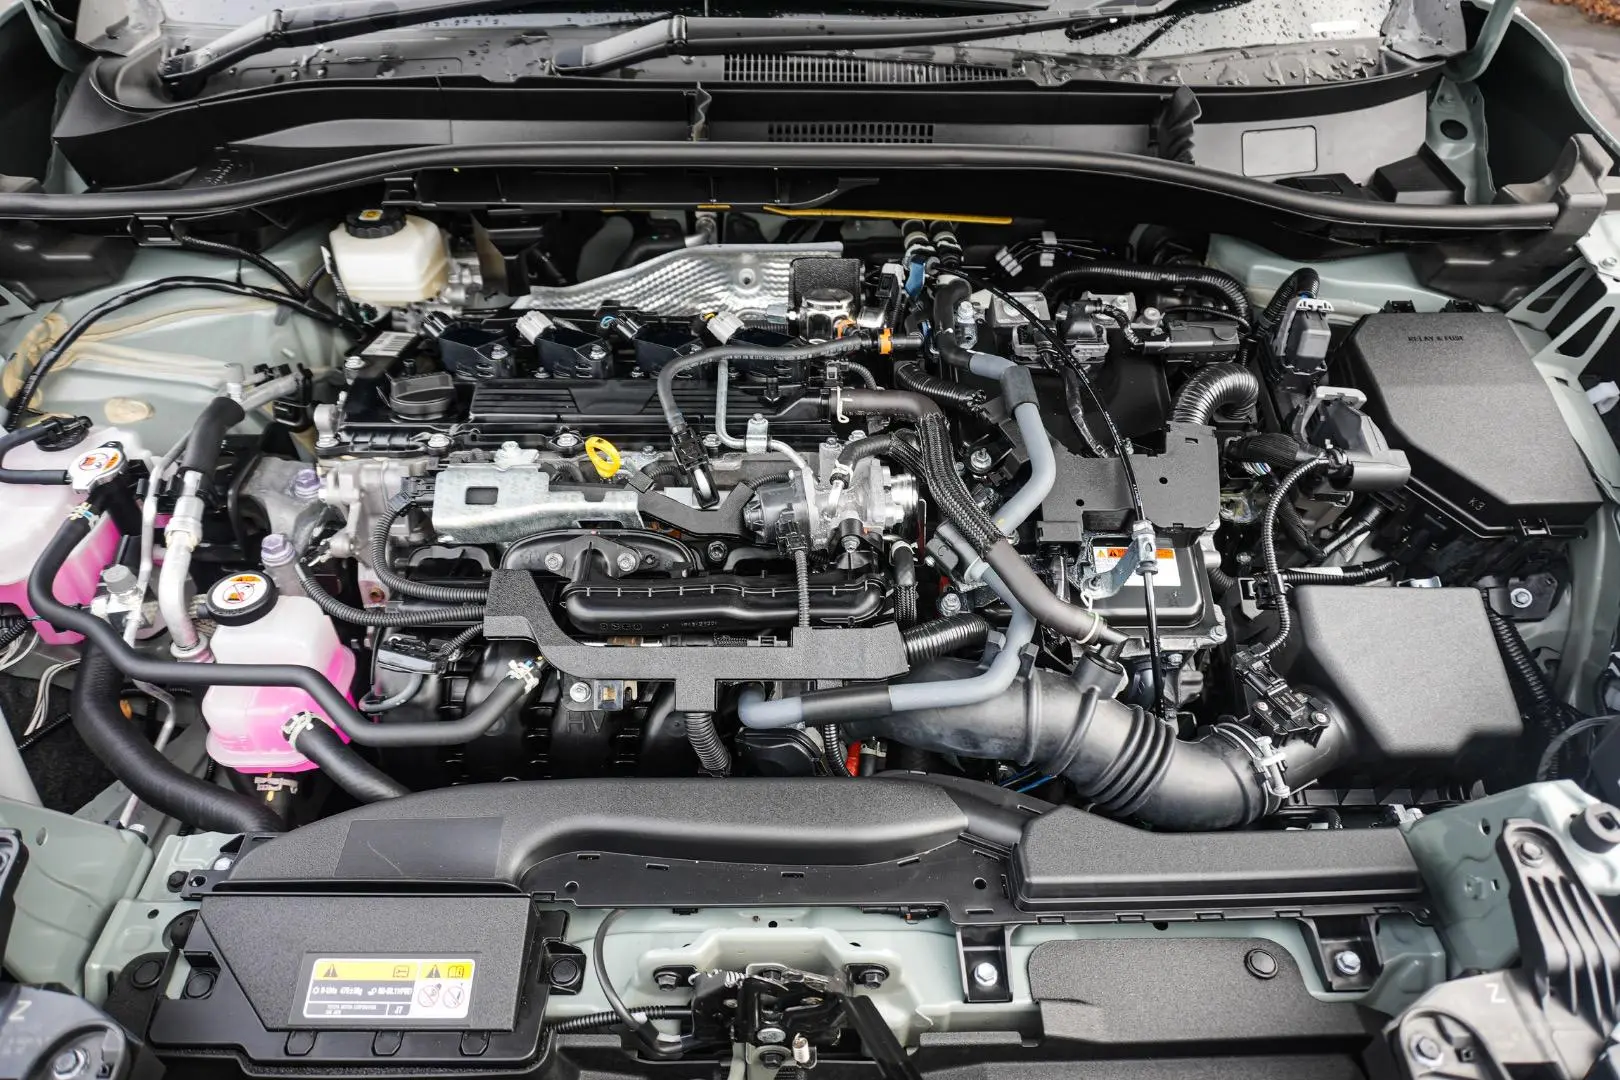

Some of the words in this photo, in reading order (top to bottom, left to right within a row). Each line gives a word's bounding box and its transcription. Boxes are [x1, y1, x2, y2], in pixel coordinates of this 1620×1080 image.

[566, 710, 606, 733] HV
[1485, 982, 1507, 1003] Z
[8, 1000, 32, 1021] Z
